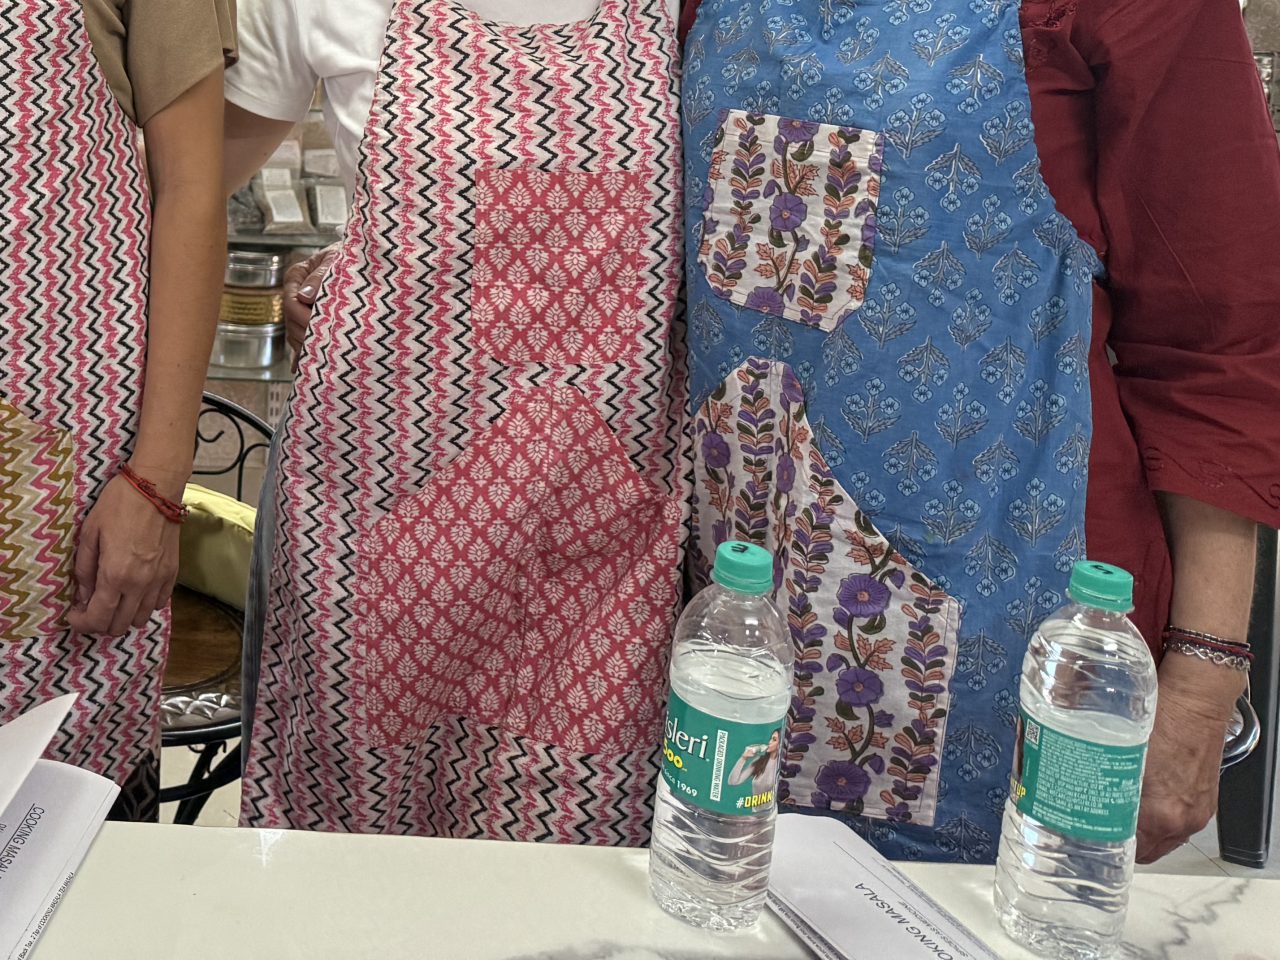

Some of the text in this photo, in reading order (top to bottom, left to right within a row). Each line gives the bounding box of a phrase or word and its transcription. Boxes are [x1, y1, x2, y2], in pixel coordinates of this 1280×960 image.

[677, 780, 698, 797] 1969
[12, 806, 45, 845] COOKING
[855, 883, 910, 924] MASALA
